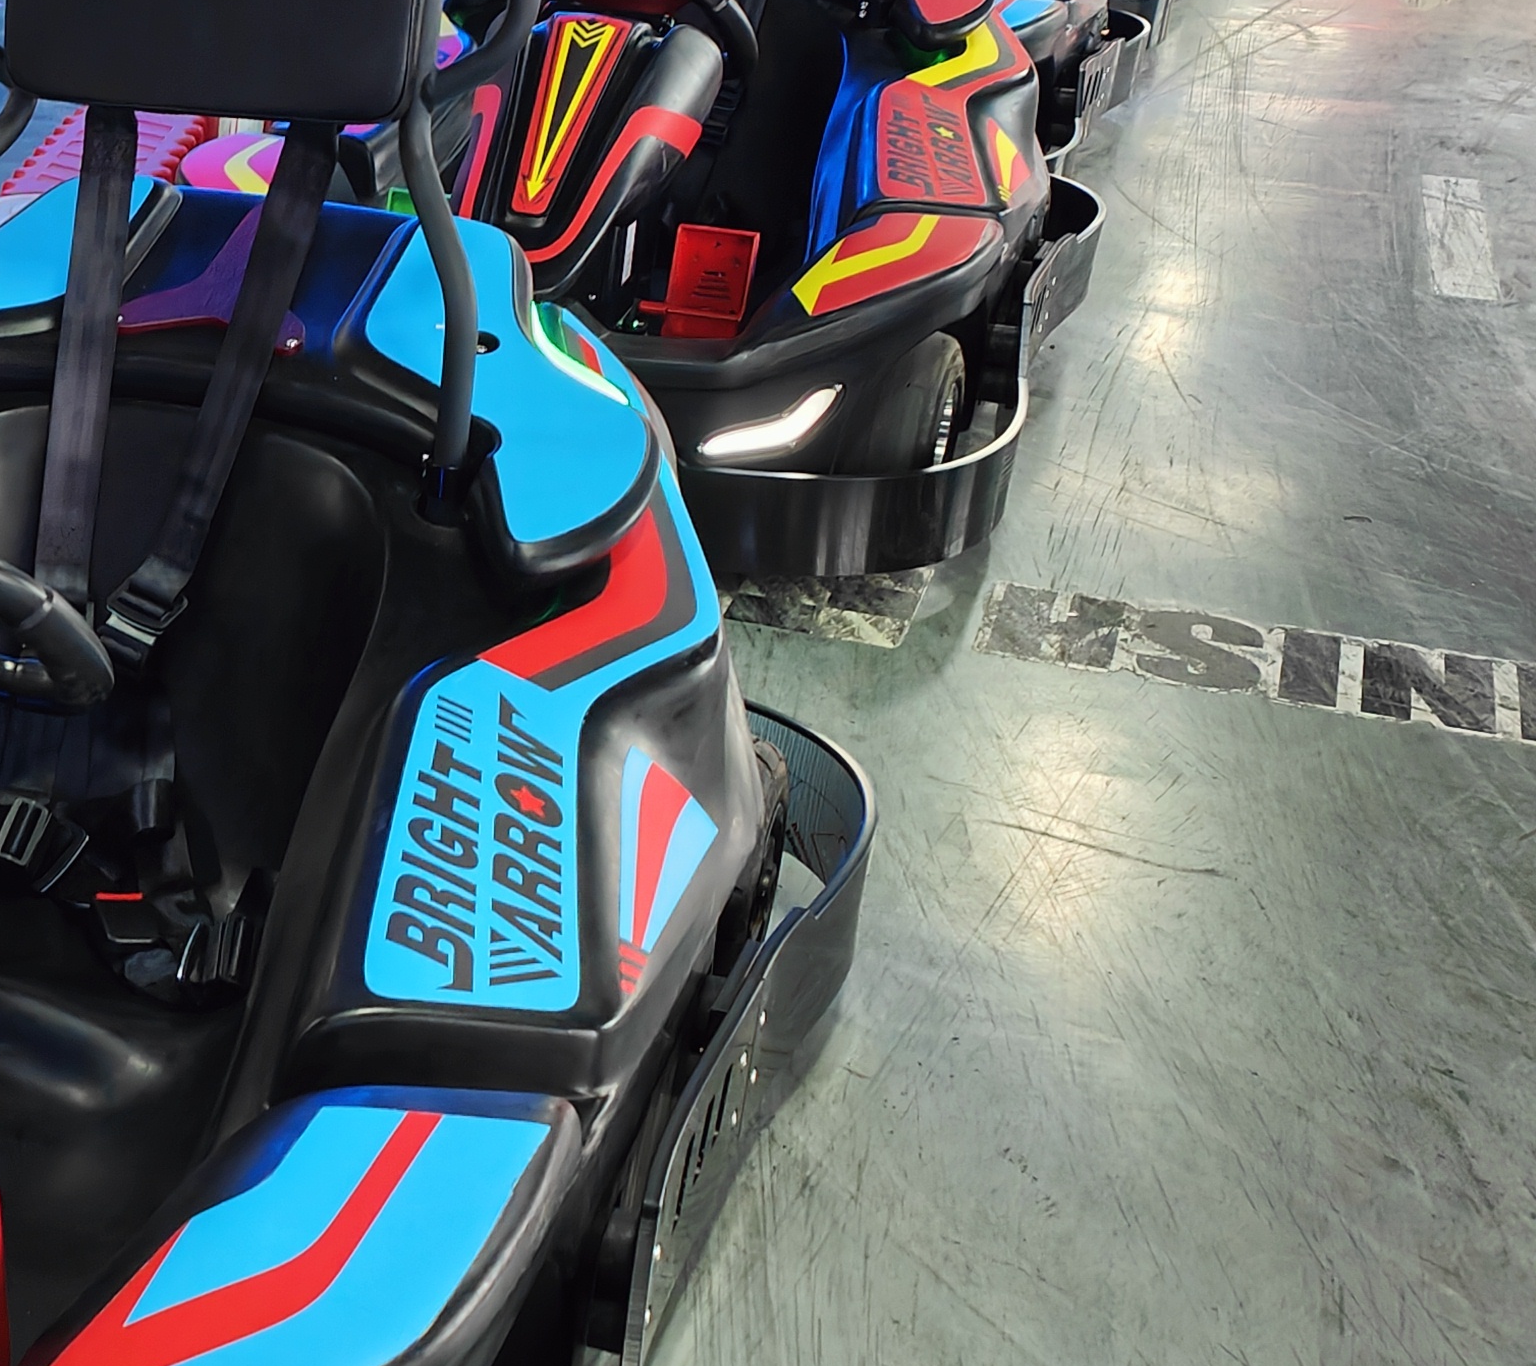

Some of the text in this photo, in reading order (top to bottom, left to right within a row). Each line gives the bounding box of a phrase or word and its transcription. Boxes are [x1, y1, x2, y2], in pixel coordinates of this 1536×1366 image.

[886, 109, 935, 197] BRIGHT
[921, 91, 976, 189] ARROW
[385, 739, 482, 992] BRIGHT
[491, 691, 564, 965] ARROW
